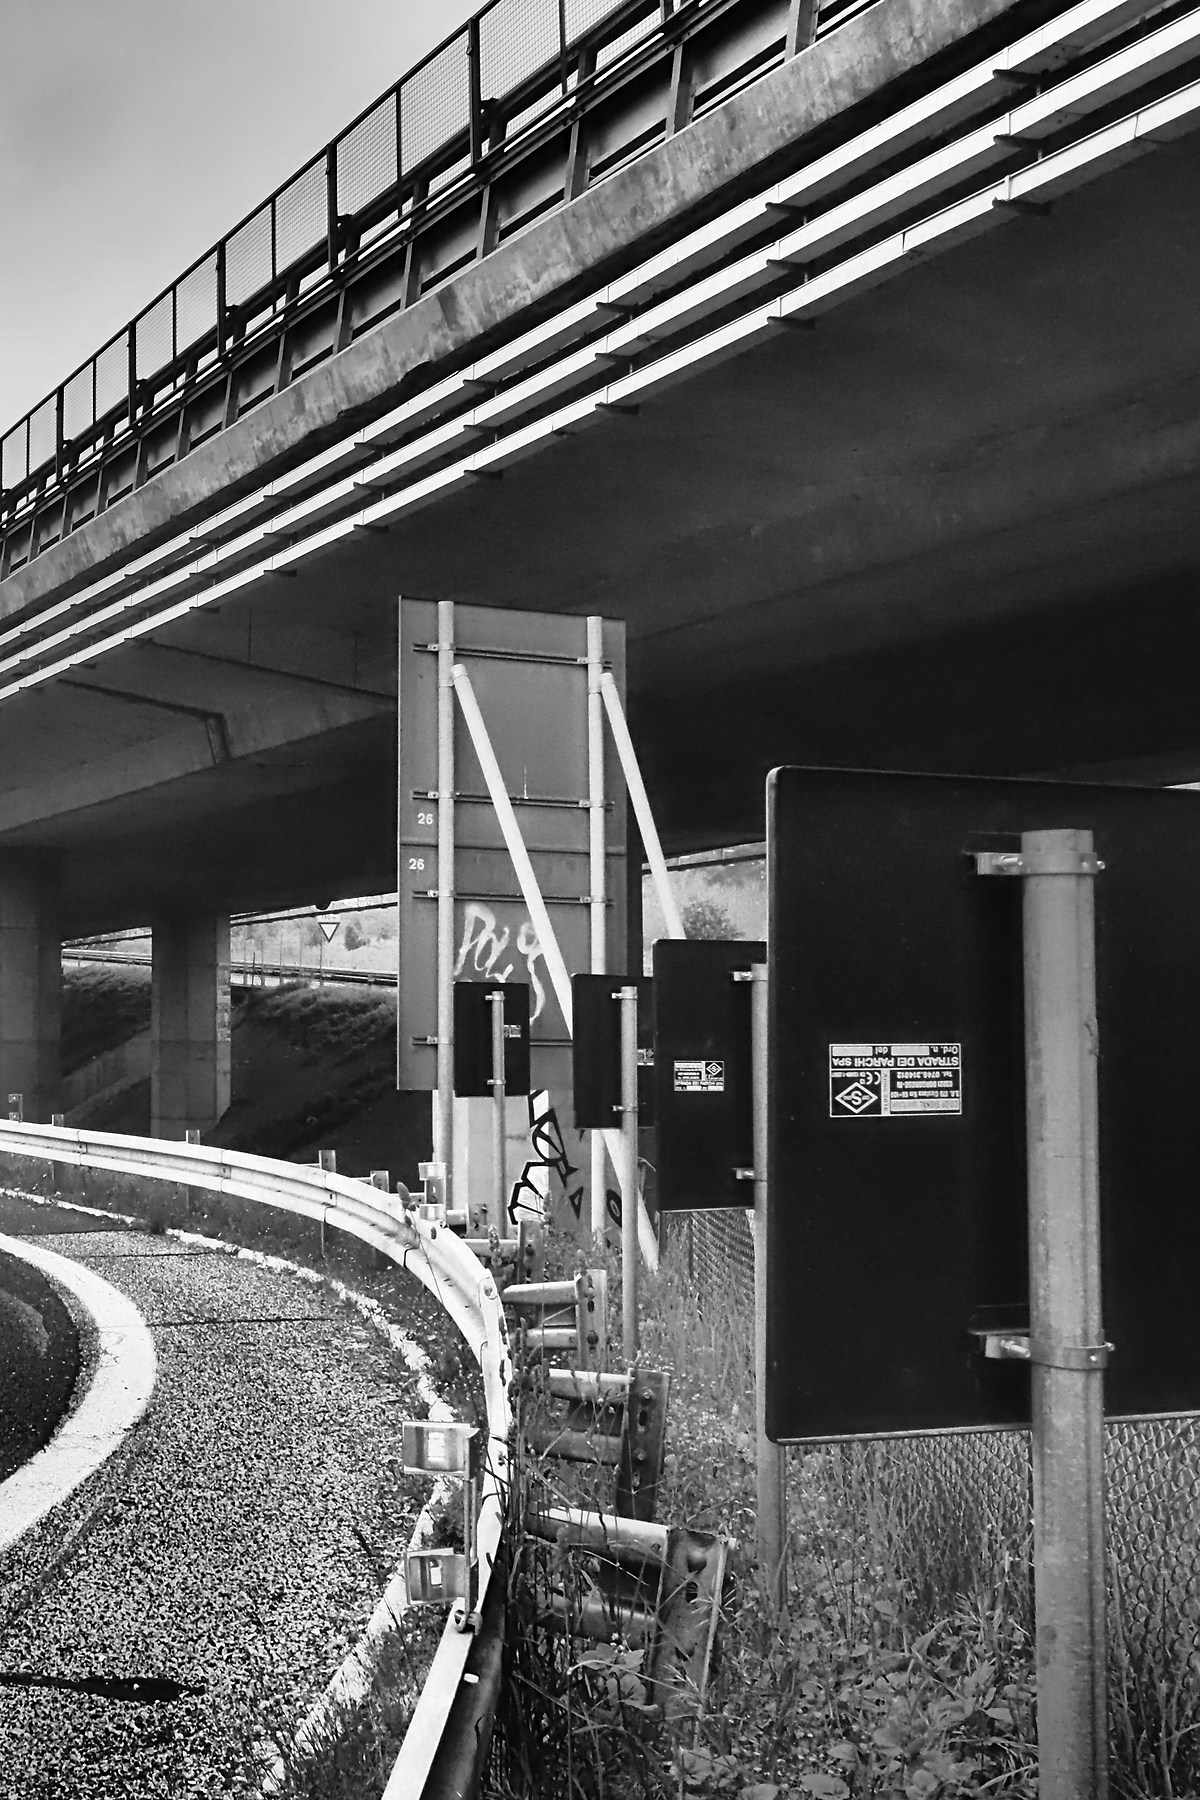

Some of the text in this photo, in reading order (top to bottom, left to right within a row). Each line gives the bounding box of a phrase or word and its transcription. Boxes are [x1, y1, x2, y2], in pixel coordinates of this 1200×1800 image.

[417, 812, 434, 825] 26
[408, 858, 425, 871] 26
[875, 1046, 889, 1055] del
[941, 1045, 959, 1054] Ord.
[832, 1056, 959, 1067] STRADA DEI PARCHI SPA
